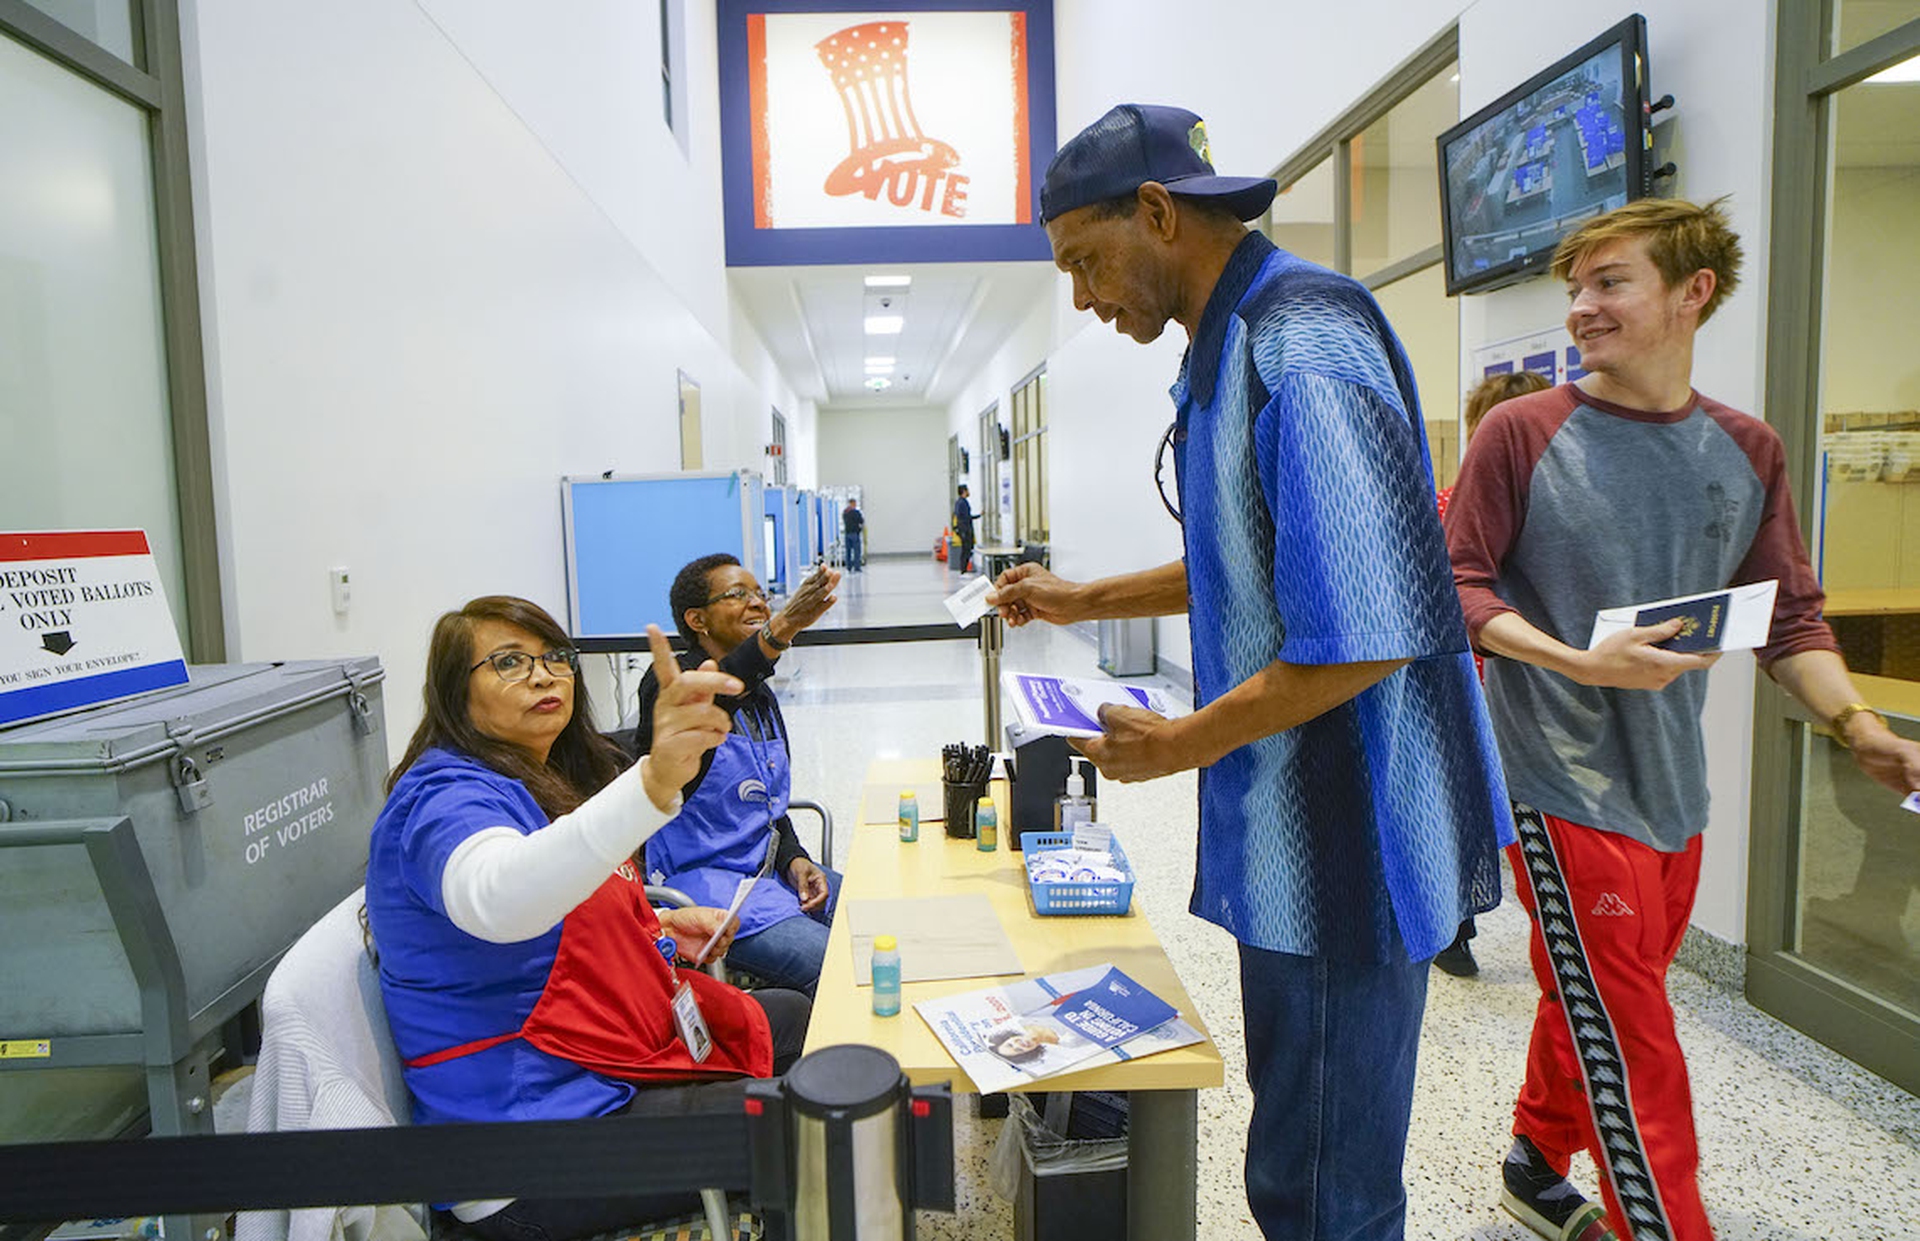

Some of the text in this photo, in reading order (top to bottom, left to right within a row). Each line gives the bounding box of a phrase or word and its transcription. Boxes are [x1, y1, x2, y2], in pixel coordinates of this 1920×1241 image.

[855, 159, 970, 217] VOTE
[10, 581, 154, 609] VOTED BALLOTS
[20, 609, 72, 630] ONLY
[0, 672, 21, 685] YOU
[25, 667, 52, 681] SIGN
[54, 663, 83, 675] YOUR
[243, 777, 329, 836] REGISTRAR
[245, 802, 334, 864] OF VOTERS
[1064, 1011, 1081, 1023] TO
[1083, 1000, 1139, 1033] CALIFORNIA
